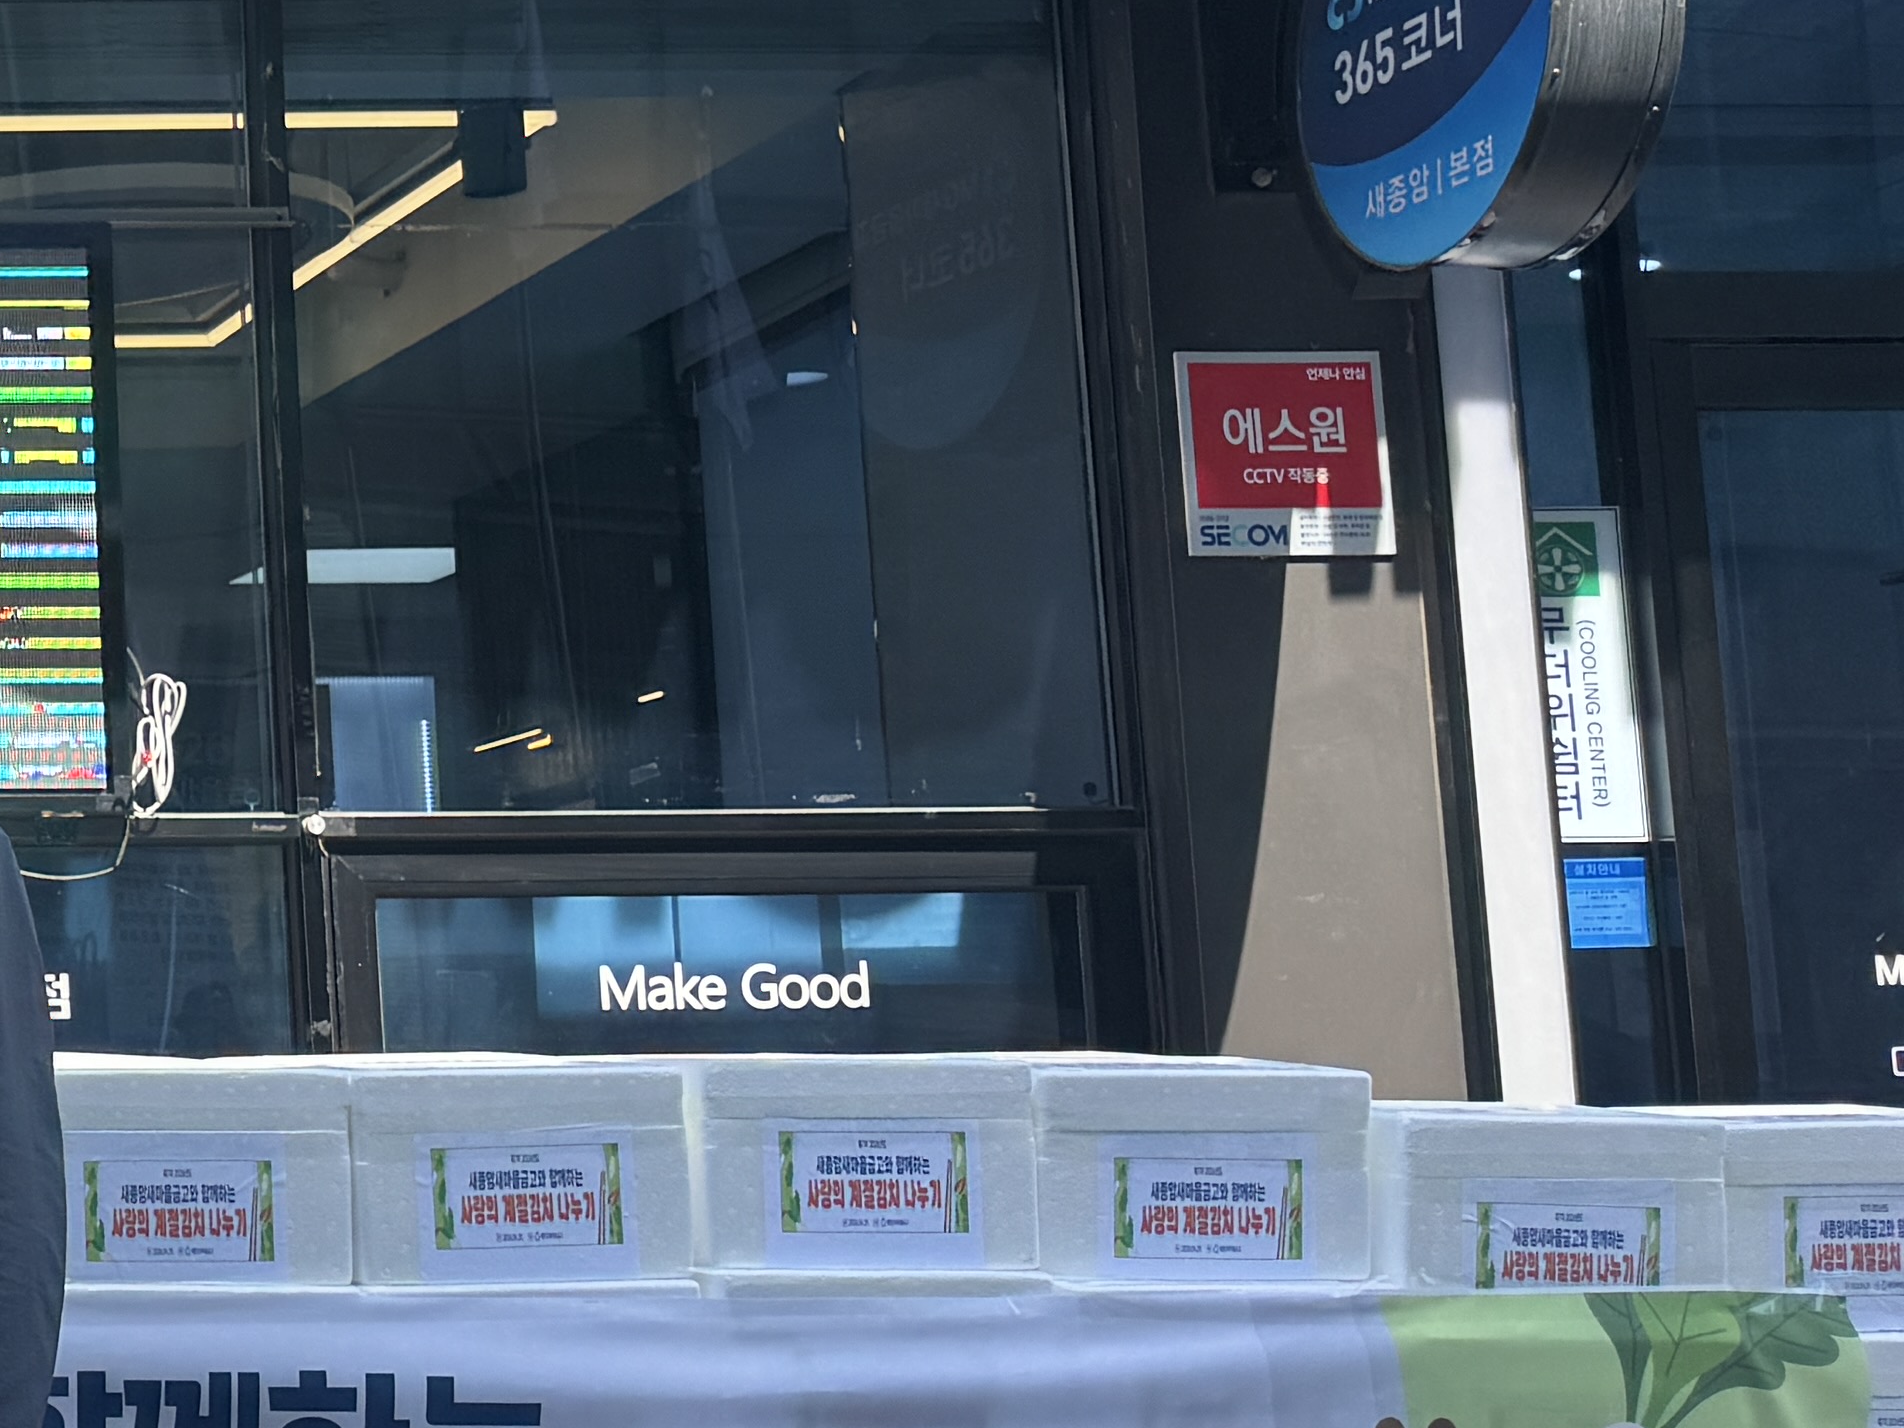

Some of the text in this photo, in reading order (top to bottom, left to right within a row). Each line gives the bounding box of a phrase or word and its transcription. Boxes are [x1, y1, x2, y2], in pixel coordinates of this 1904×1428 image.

[1335, 27, 1394, 104] 365
[1366, 135, 1493, 217] 새종암 본점
[1223, 407, 1347, 453] 에스원
[1244, 468, 1330, 484] CCTV 작동중
[1200, 524, 1289, 546] SECOM
[1576, 620, 1611, 807] (COOLING CENTER)
[599, 960, 870, 1010] Make Good
[1141, 1205, 1178, 1235] 사랑의
[1238, 1206, 1275, 1236] 나누기
